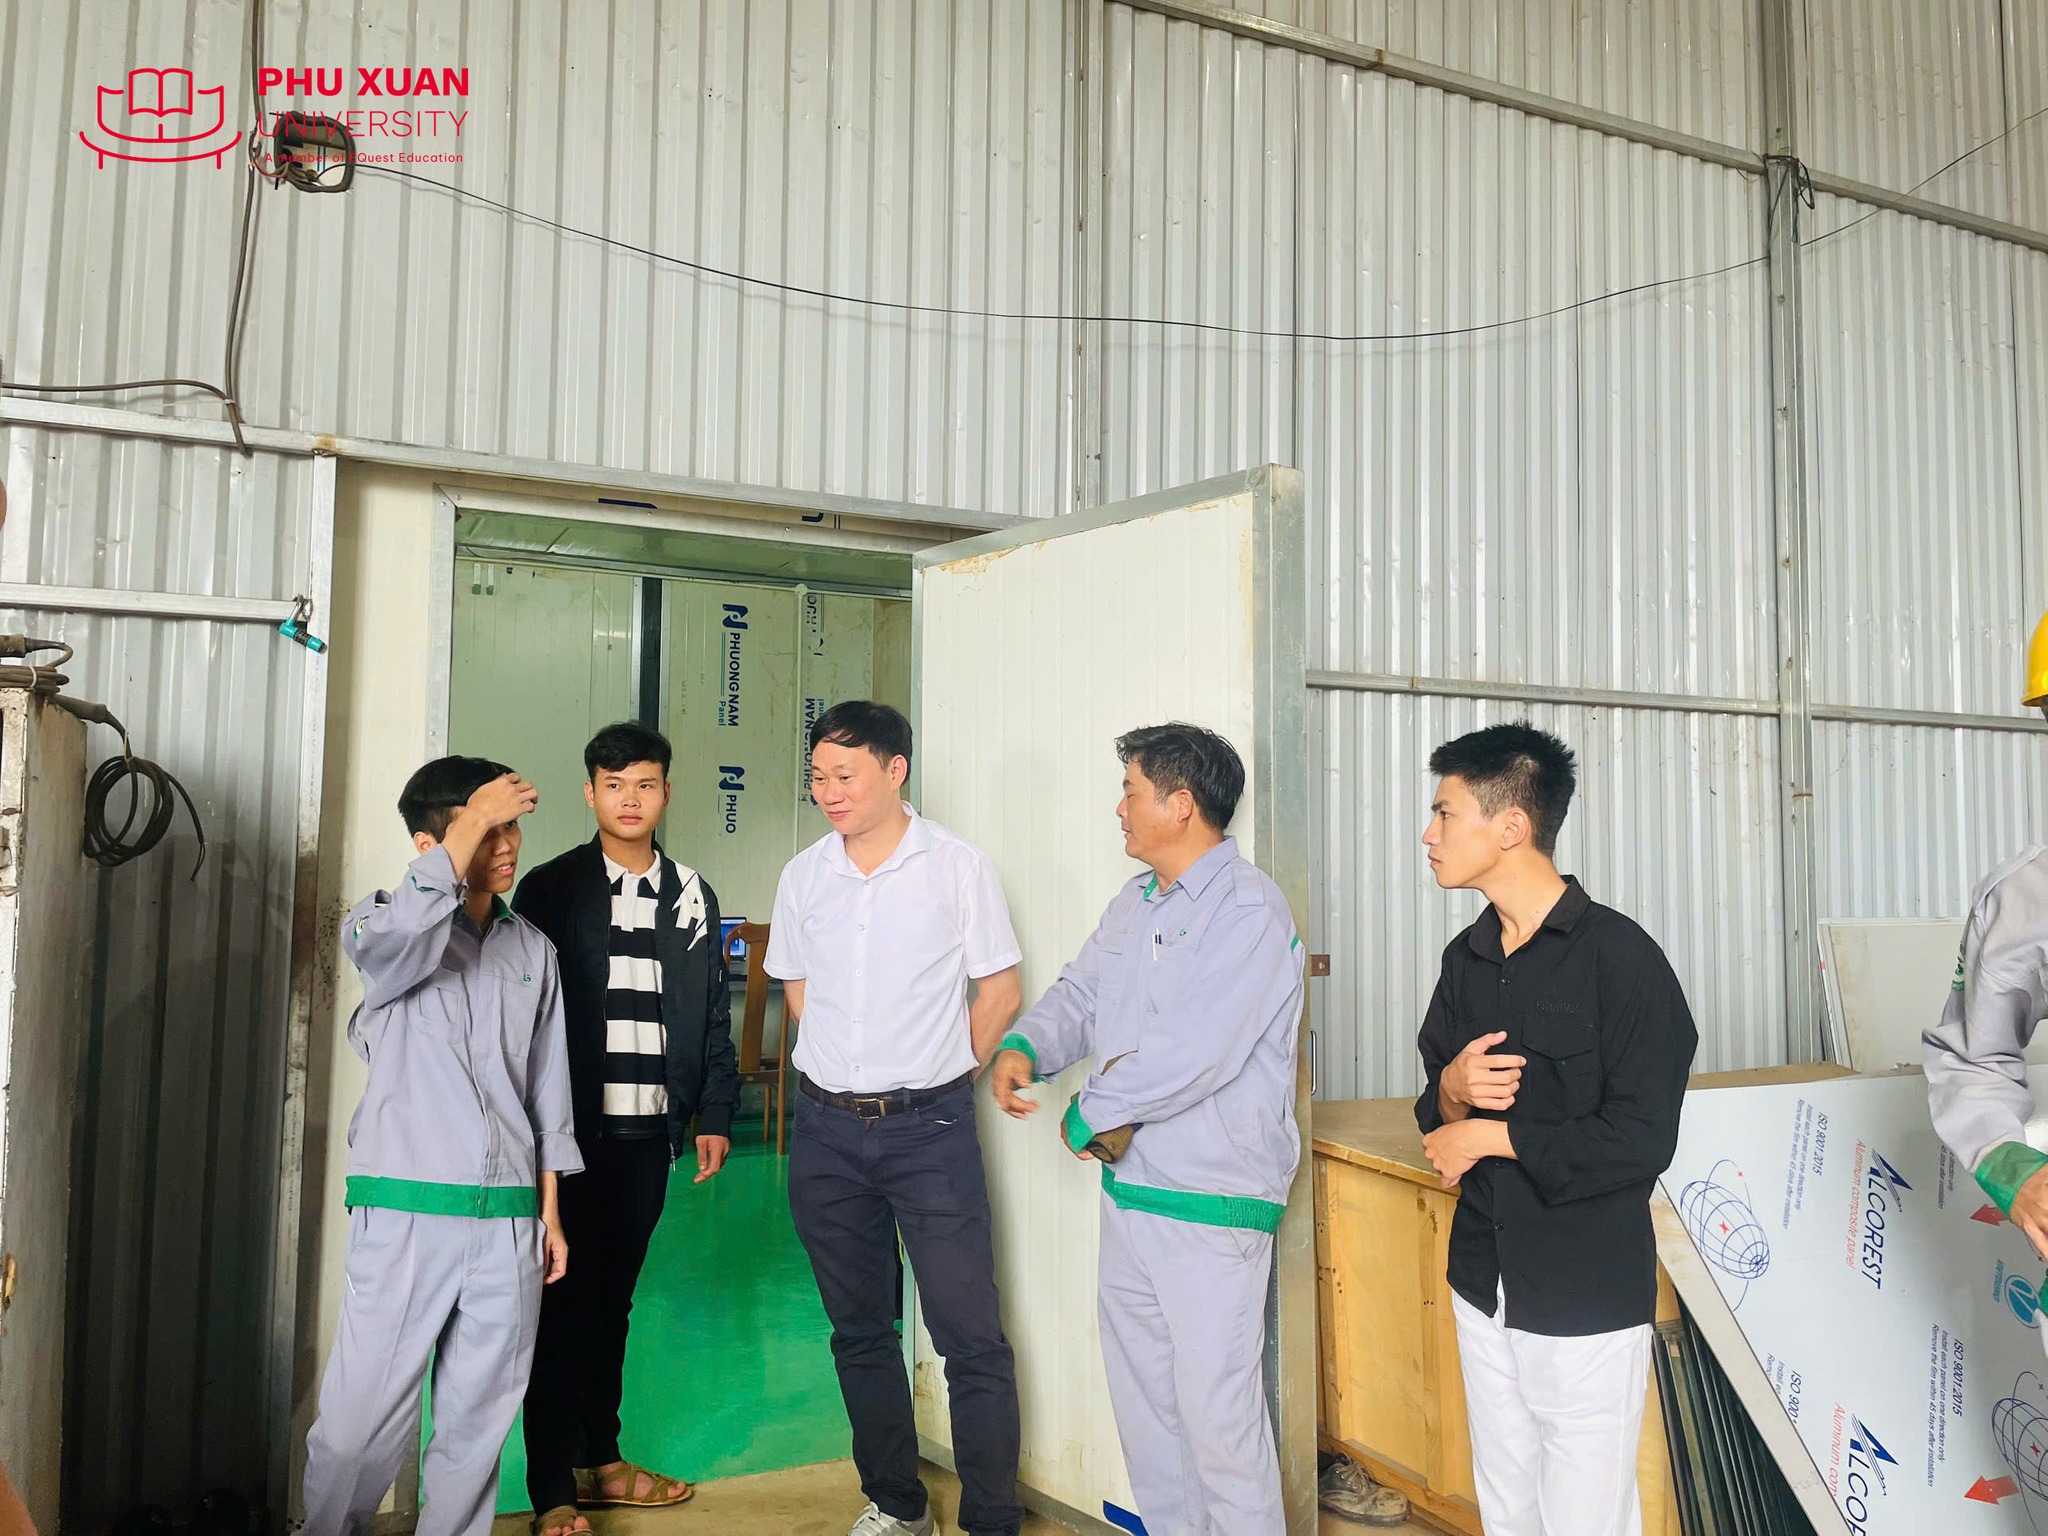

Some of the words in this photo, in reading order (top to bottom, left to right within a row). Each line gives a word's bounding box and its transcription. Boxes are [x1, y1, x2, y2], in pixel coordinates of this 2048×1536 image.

[728, 632, 741, 691] PHUONG
[718, 701, 727, 726] Panel
[727, 694, 739, 727] NAM
[725, 794, 738, 833] PHUO
[1817, 1112, 1828, 1131] ISO
[1851, 1138, 1867, 1187] Aluminum
[1847, 1186, 1861, 1238] composite
[1861, 1148, 1913, 1290] ALCOREST
[1931, 1323, 1940, 1352] Remove
[1953, 1338, 1964, 1361] ISO
[1930, 1353, 1938, 1365] the
[1790, 1370, 1802, 1393] ISO
[1929, 1379, 1937, 1400] within
[1939, 1370, 1947, 1391] panel
[1831, 1402, 1847, 1467] Aluminum
[1927, 1412, 1936, 1430] days
[1938, 1416, 1946, 1446] direction
[1928, 1430, 1936, 1448] after
